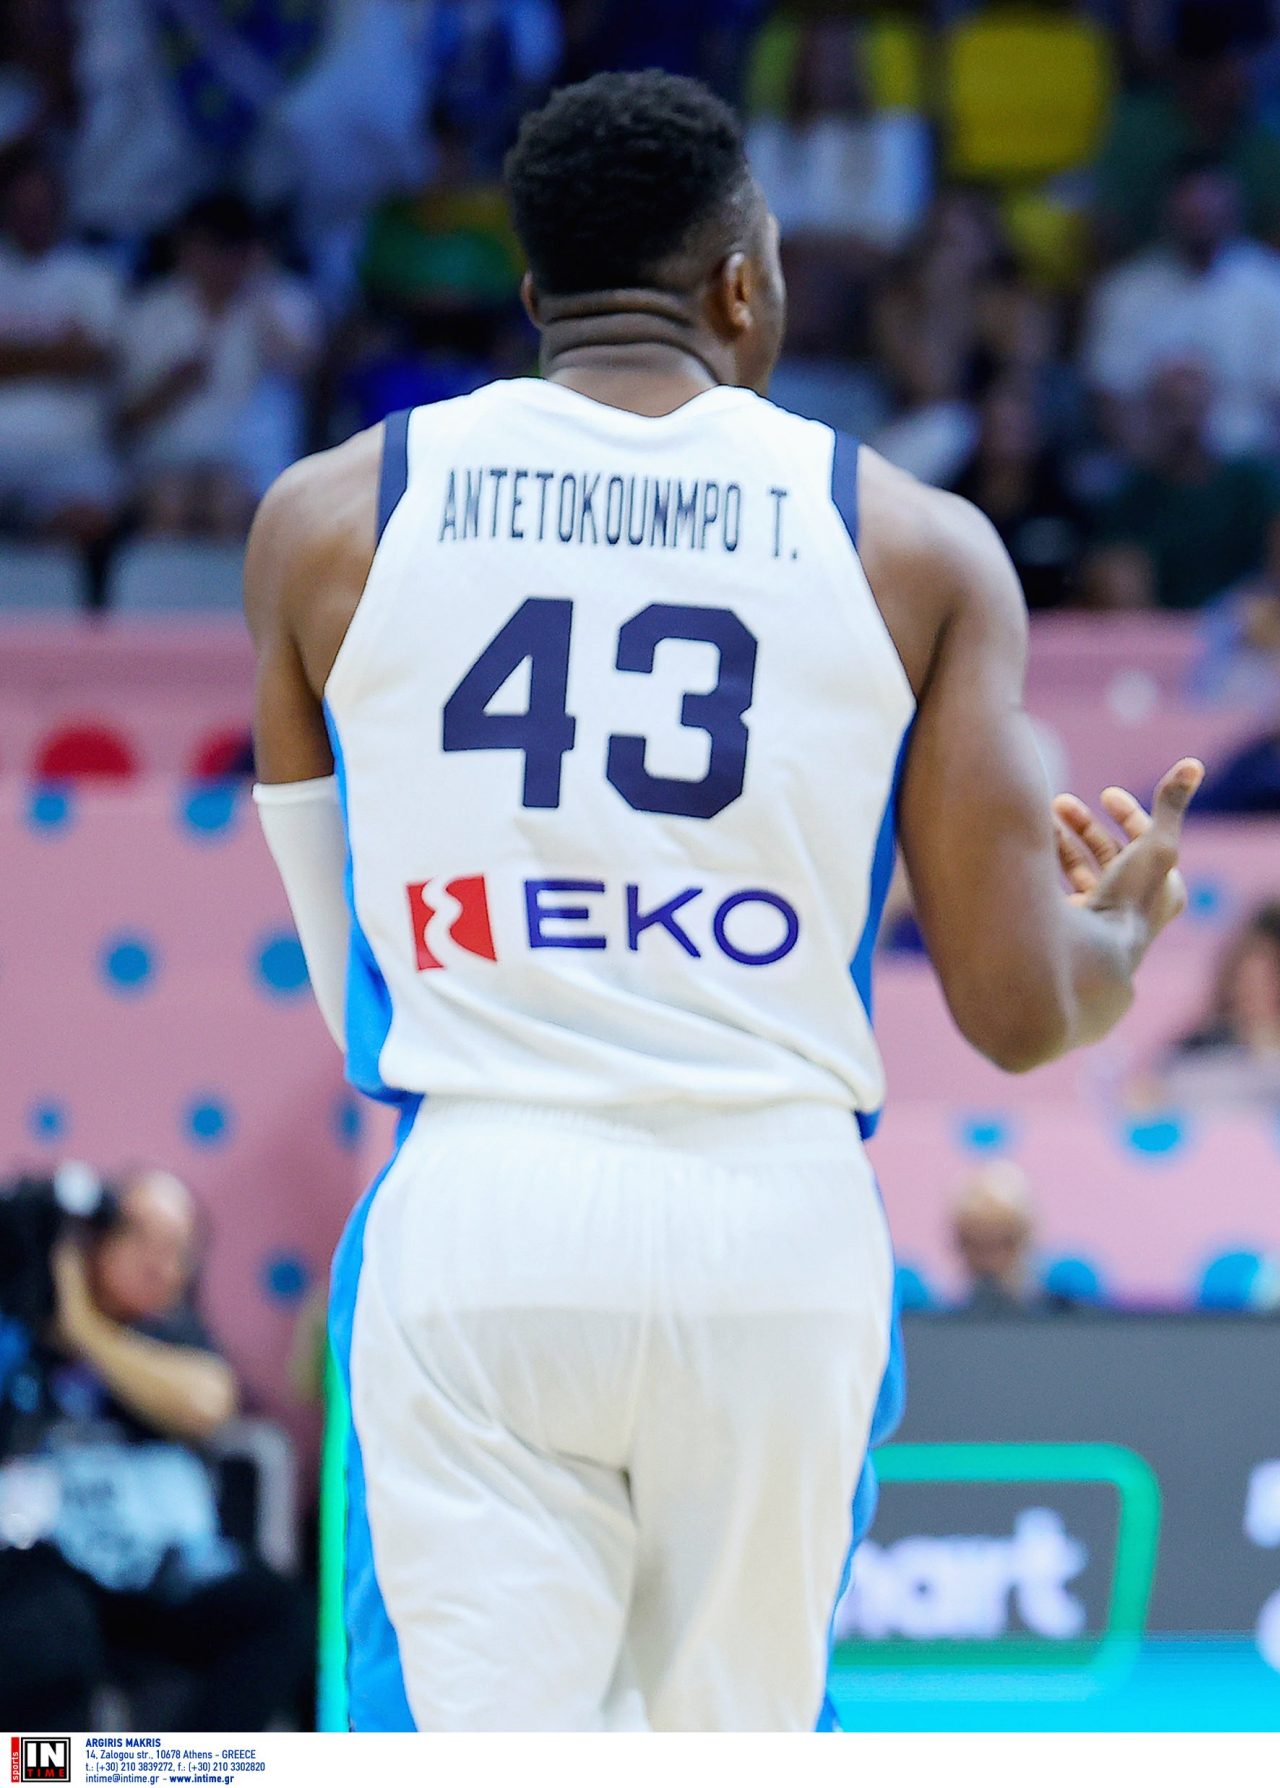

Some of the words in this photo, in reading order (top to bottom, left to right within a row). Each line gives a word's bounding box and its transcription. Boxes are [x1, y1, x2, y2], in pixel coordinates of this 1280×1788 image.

[438, 468, 742, 552] ANTETOKOUNMPO
[766, 486, 797, 559] T.
[442, 596, 757, 819] 43
[523, 878, 799, 966] EKO
